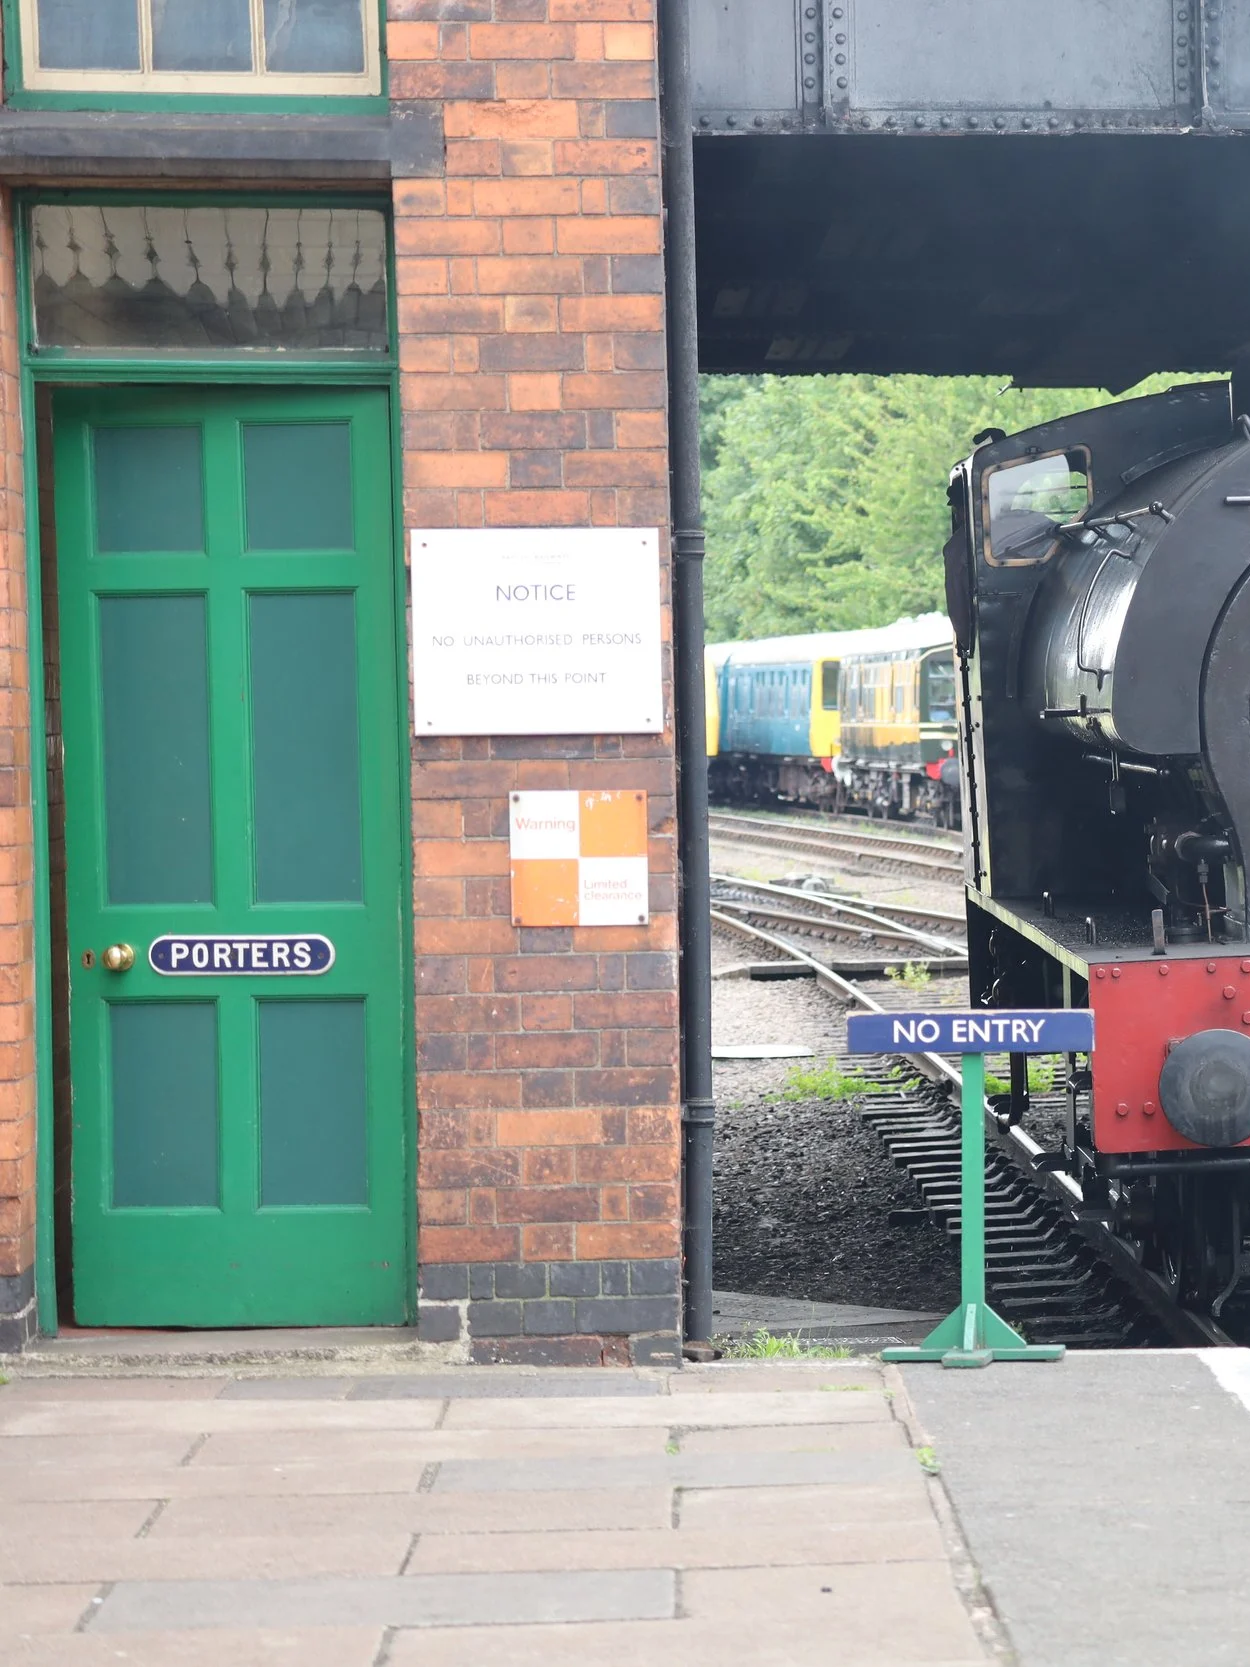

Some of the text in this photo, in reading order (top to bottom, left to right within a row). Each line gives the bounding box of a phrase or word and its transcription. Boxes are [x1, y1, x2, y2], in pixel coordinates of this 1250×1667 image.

[495, 583, 576, 602] NOTICE
[432, 632, 642, 647] NO UNAUTHORISED PERSONS
[466, 671, 607, 686] BEYOND THIS POINT
[515, 817, 576, 832] Warning
[583, 879, 628, 890] Limited
[583, 890, 642, 901] clearance
[170, 941, 312, 969] PORTERS
[892, 1019, 1046, 1044] NO ENTRY
